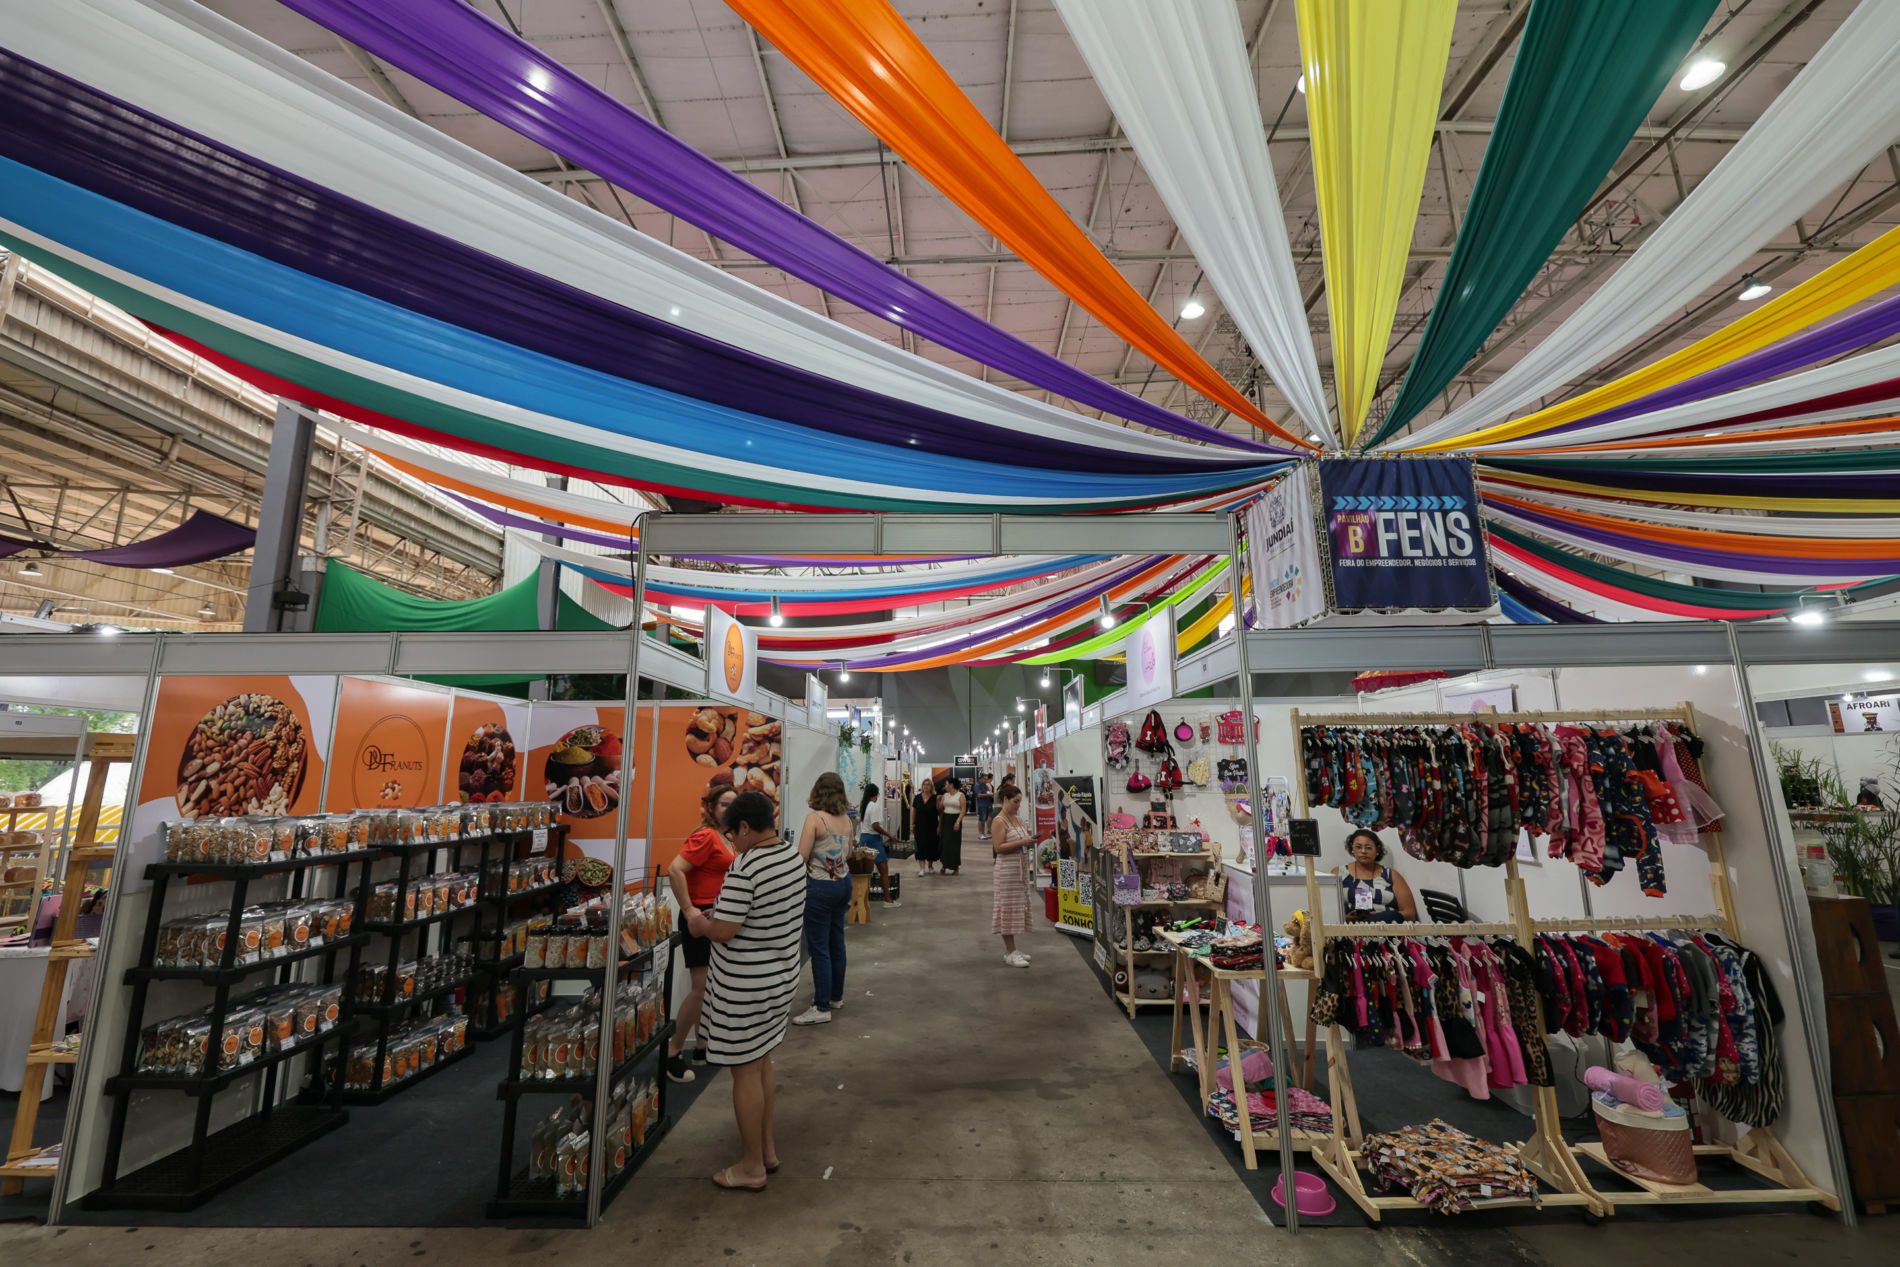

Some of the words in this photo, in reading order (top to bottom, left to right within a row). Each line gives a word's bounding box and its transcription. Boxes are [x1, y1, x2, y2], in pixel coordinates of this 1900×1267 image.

[1337, 513, 1370, 524] PAVILHÃO
[1266, 517, 1294, 552] JUNDIAÍ
[1347, 525, 1365, 553] B
[1376, 511, 1474, 557] FENS
[1339, 559, 1356, 567] FEIRA
[1356, 559, 1365, 567] DO
[1846, 700, 1891, 711] AFROARI
